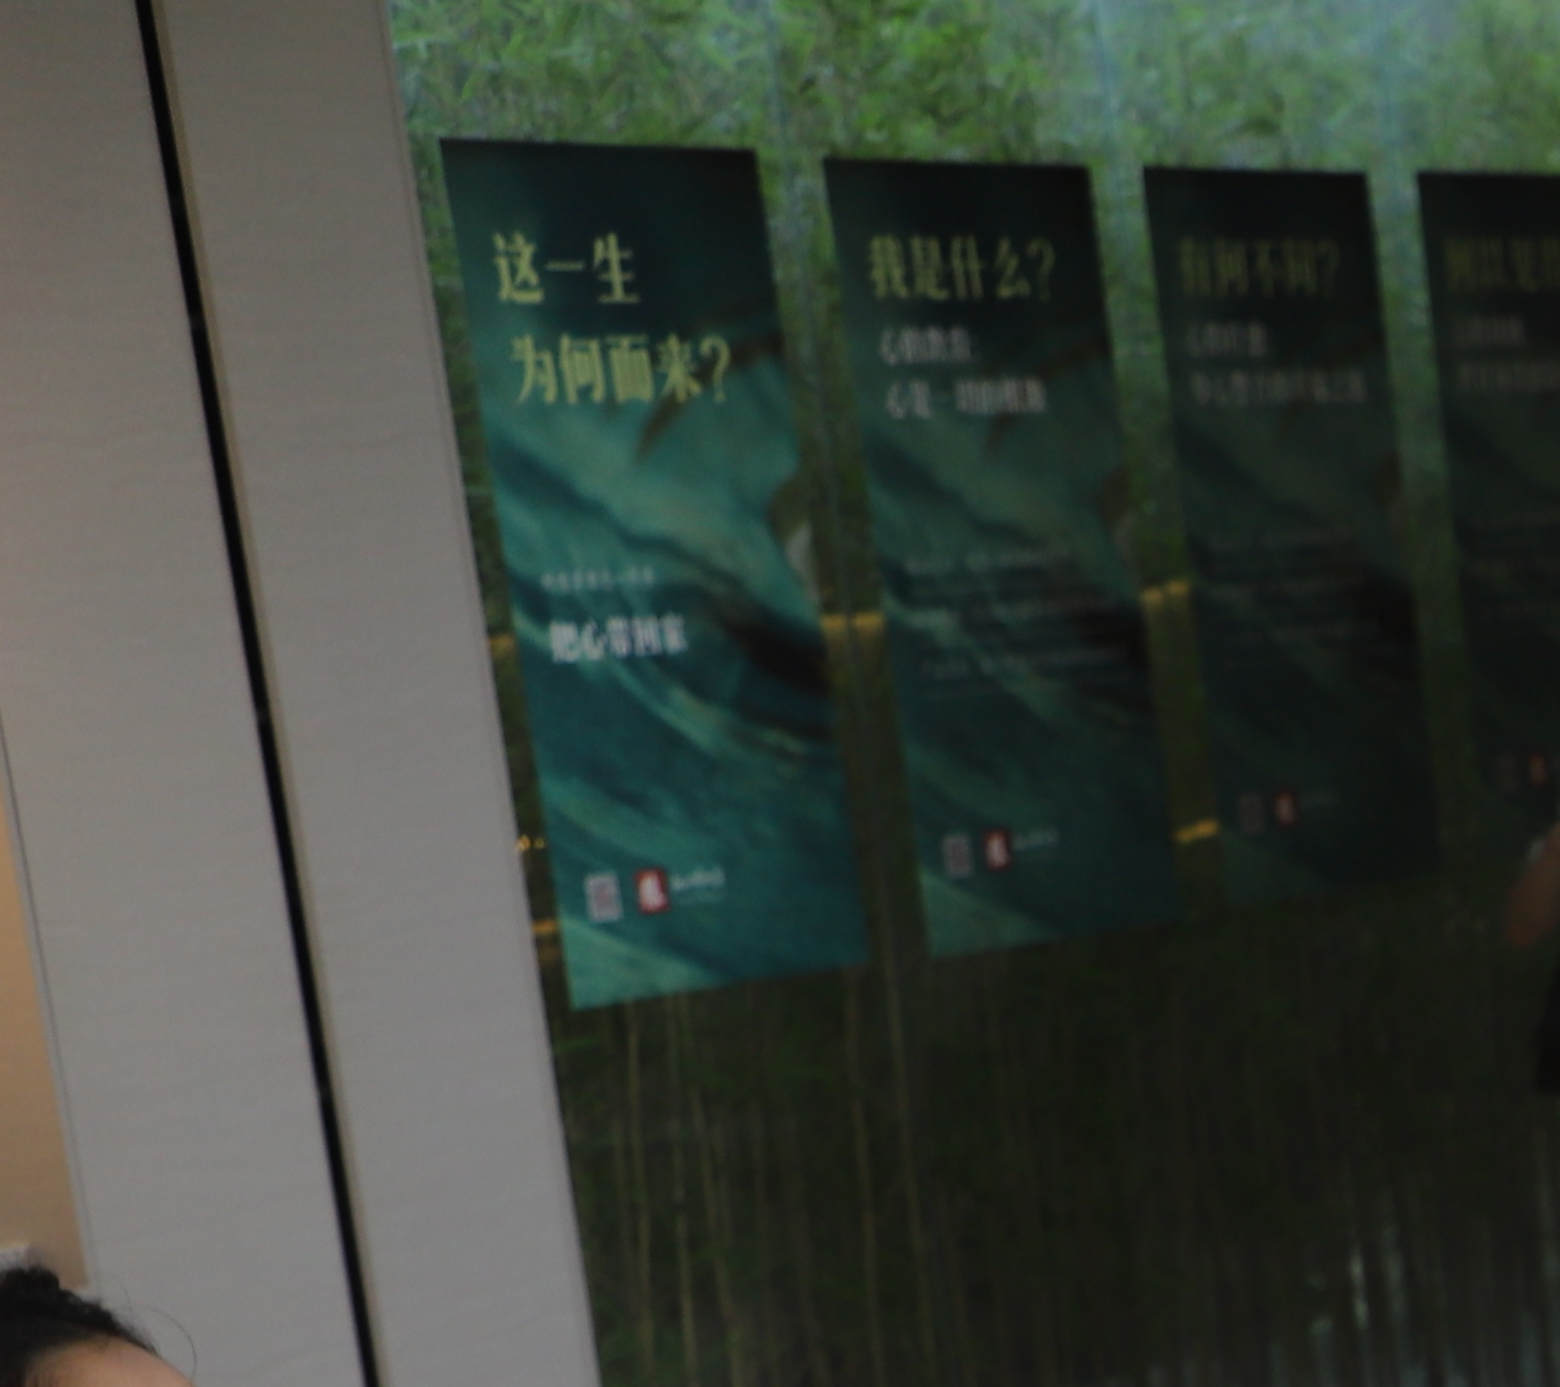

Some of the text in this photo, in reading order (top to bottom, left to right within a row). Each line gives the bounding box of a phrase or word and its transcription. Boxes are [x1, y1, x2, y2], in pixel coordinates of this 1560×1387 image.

[491, 230, 642, 305] 这一生
[868, 231, 1058, 304] 我是什么?
[510, 332, 732, 405] 为何而来?
